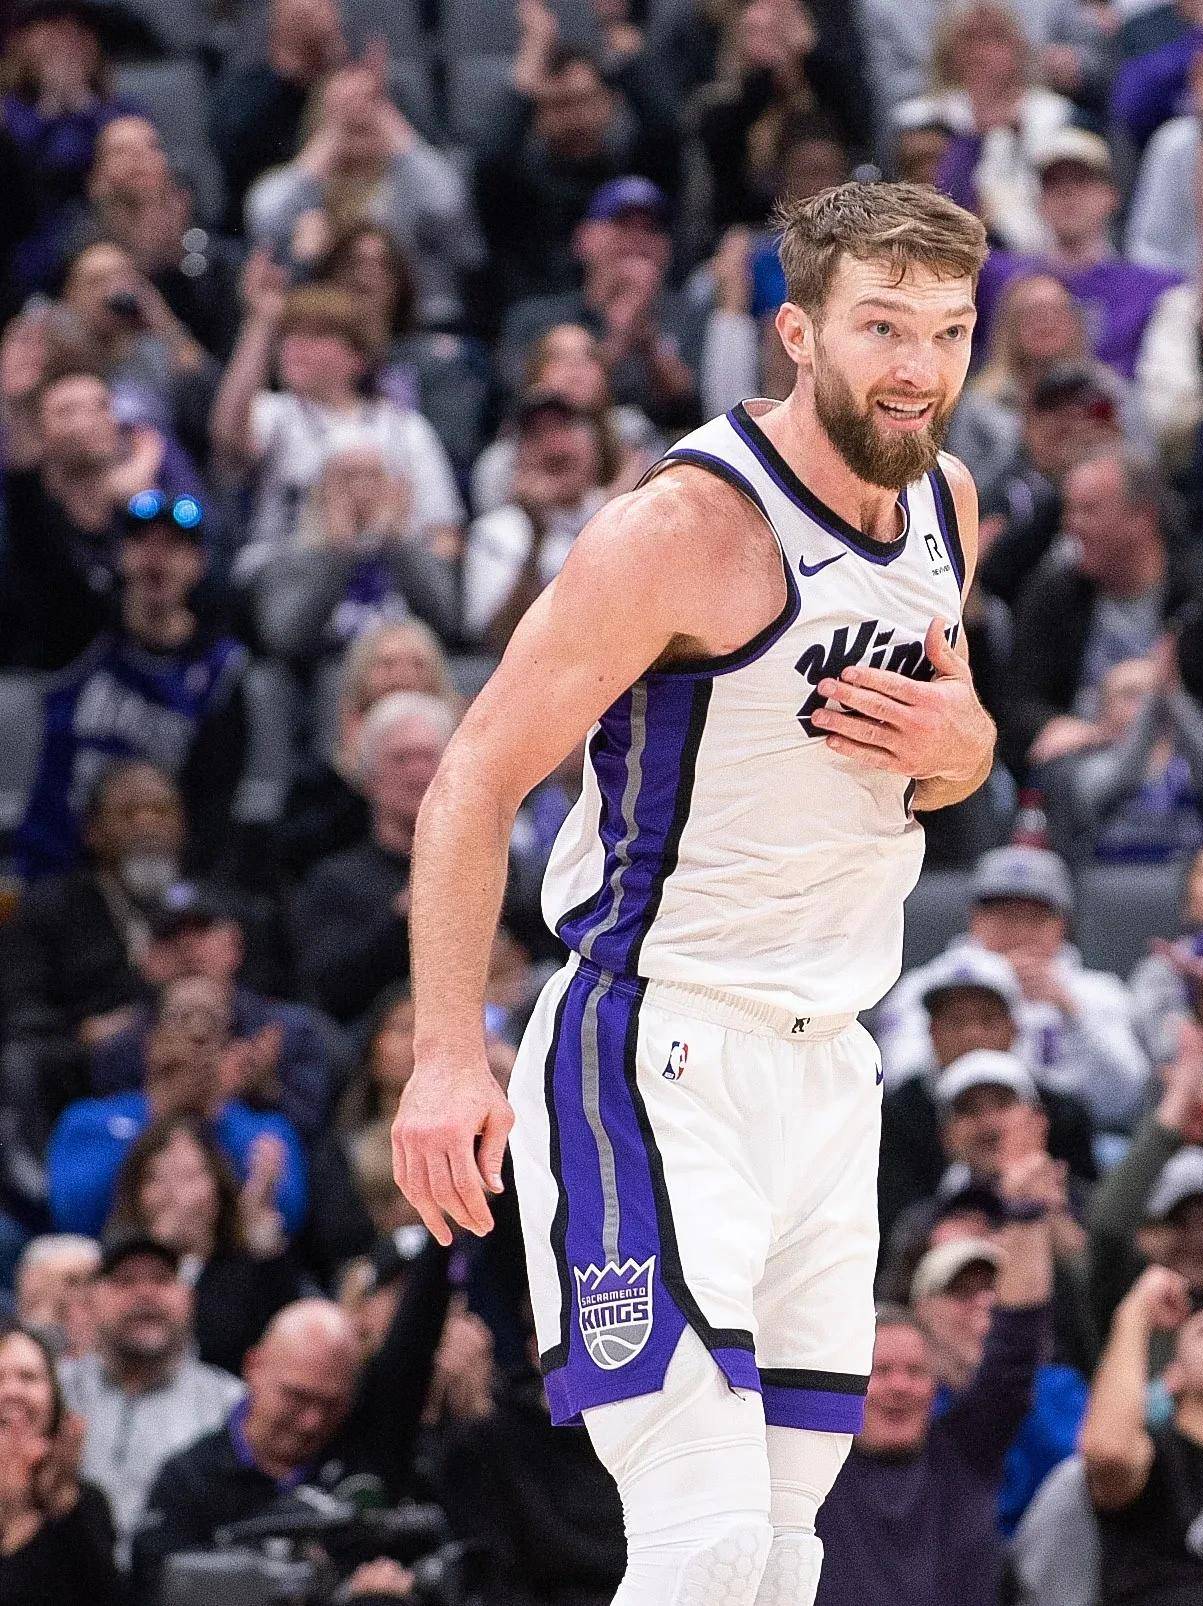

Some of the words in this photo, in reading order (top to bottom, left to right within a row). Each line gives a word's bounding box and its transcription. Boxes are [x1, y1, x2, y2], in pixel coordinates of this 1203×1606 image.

[923, 533, 943, 561] R
[794, 619, 959, 738] Kin
[581, 1286, 646, 1307] SACRAMENTO
[581, 1300, 649, 1332] KINGS
